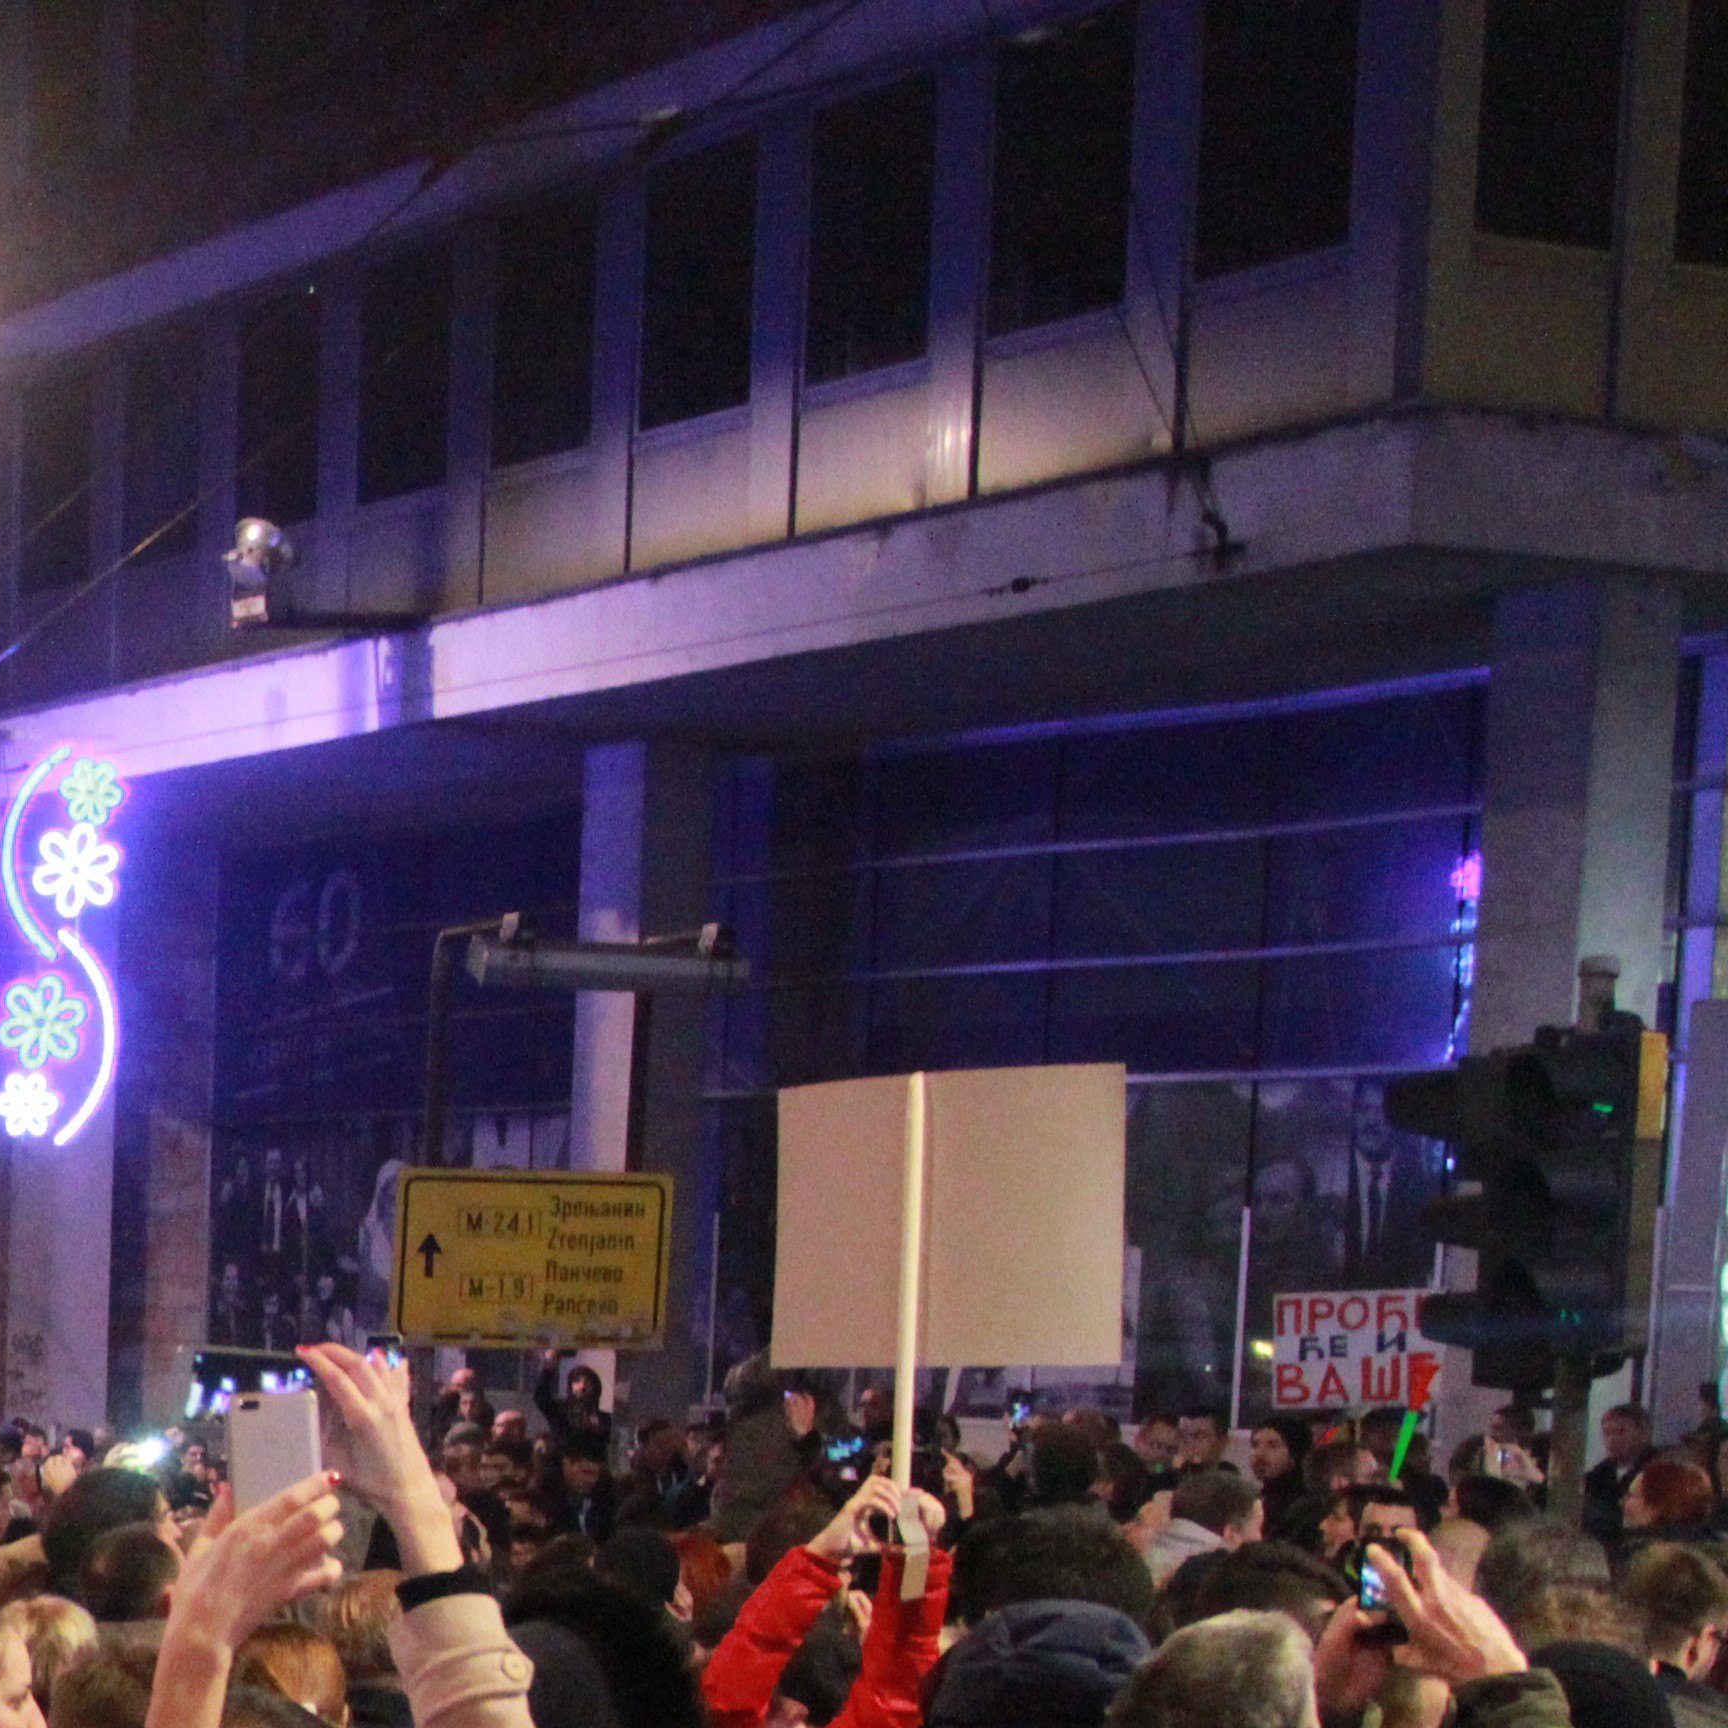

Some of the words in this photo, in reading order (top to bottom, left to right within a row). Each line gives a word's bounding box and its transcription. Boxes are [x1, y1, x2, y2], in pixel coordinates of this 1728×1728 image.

[549, 1195, 645, 1220] Зрењанин
[547, 1227, 635, 1256] Zrenjanin
[544, 1259, 624, 1284] Панчево
[1376, 1331, 1407, 1353] И
